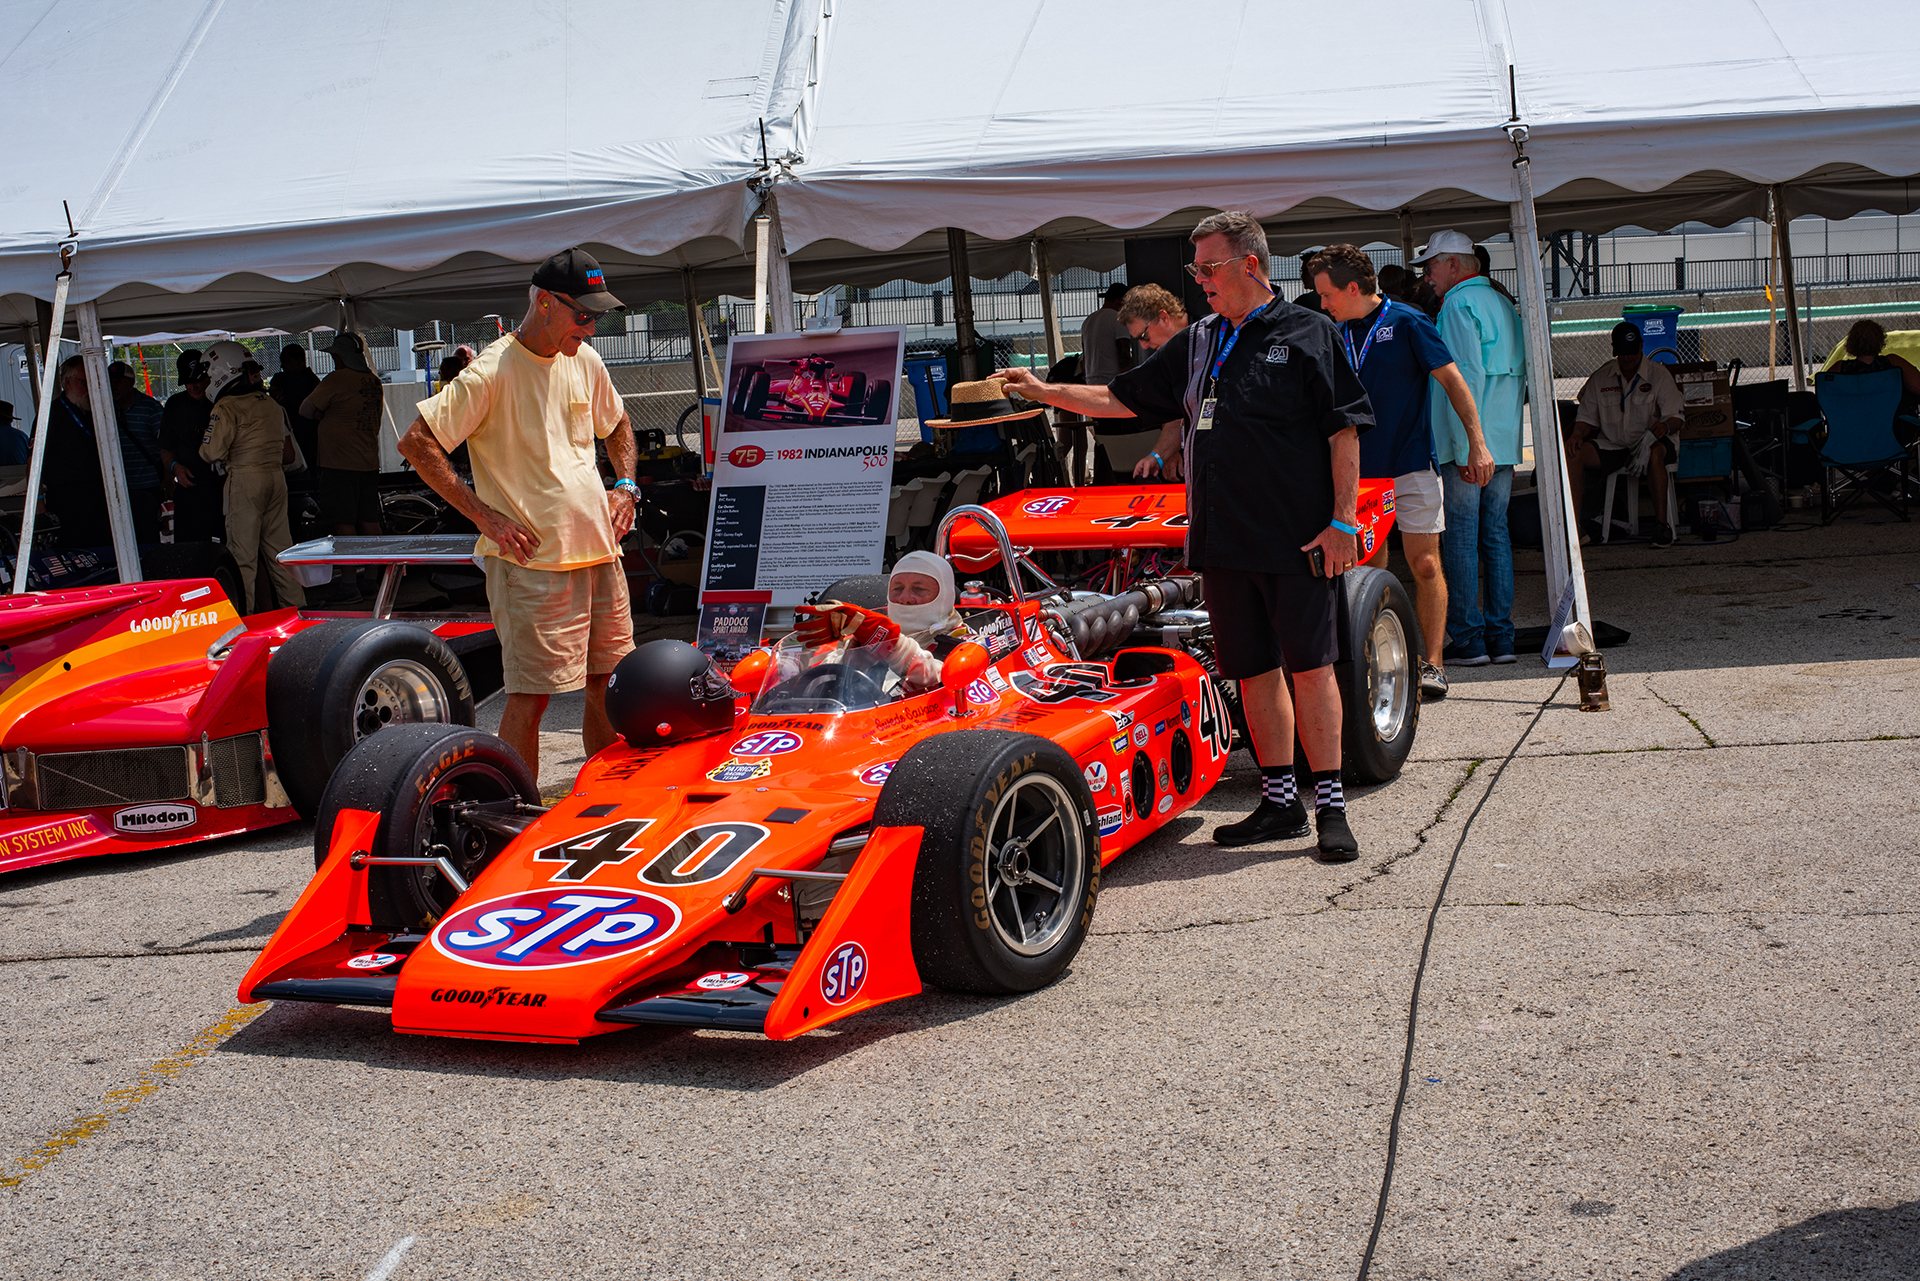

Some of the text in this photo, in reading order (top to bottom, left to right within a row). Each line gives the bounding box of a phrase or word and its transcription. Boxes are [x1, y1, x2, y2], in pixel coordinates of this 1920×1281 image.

[735, 449, 758, 464] 75
[777, 445, 888, 460] 1982 INDIANAPOLIS
[862, 456, 888, 472] 500
[712, 626, 729, 634] SPIRIT
[713, 616, 749, 627] PADDOCK
[966, 680, 993, 703] STP
[1199, 674, 1232, 762] 40
[733, 733, 797, 755] STP
[1135, 728, 1147, 742] BELL
[121, 811, 189, 827] Milodon
[11, 825, 67, 853] SYSTEM
[68, 819, 97, 839] INC.
[532, 818, 772, 887] 40
[1080, 835, 1101, 930] EAGLE
[446, 894, 660, 963] STP
[825, 945, 865, 1000] STP
